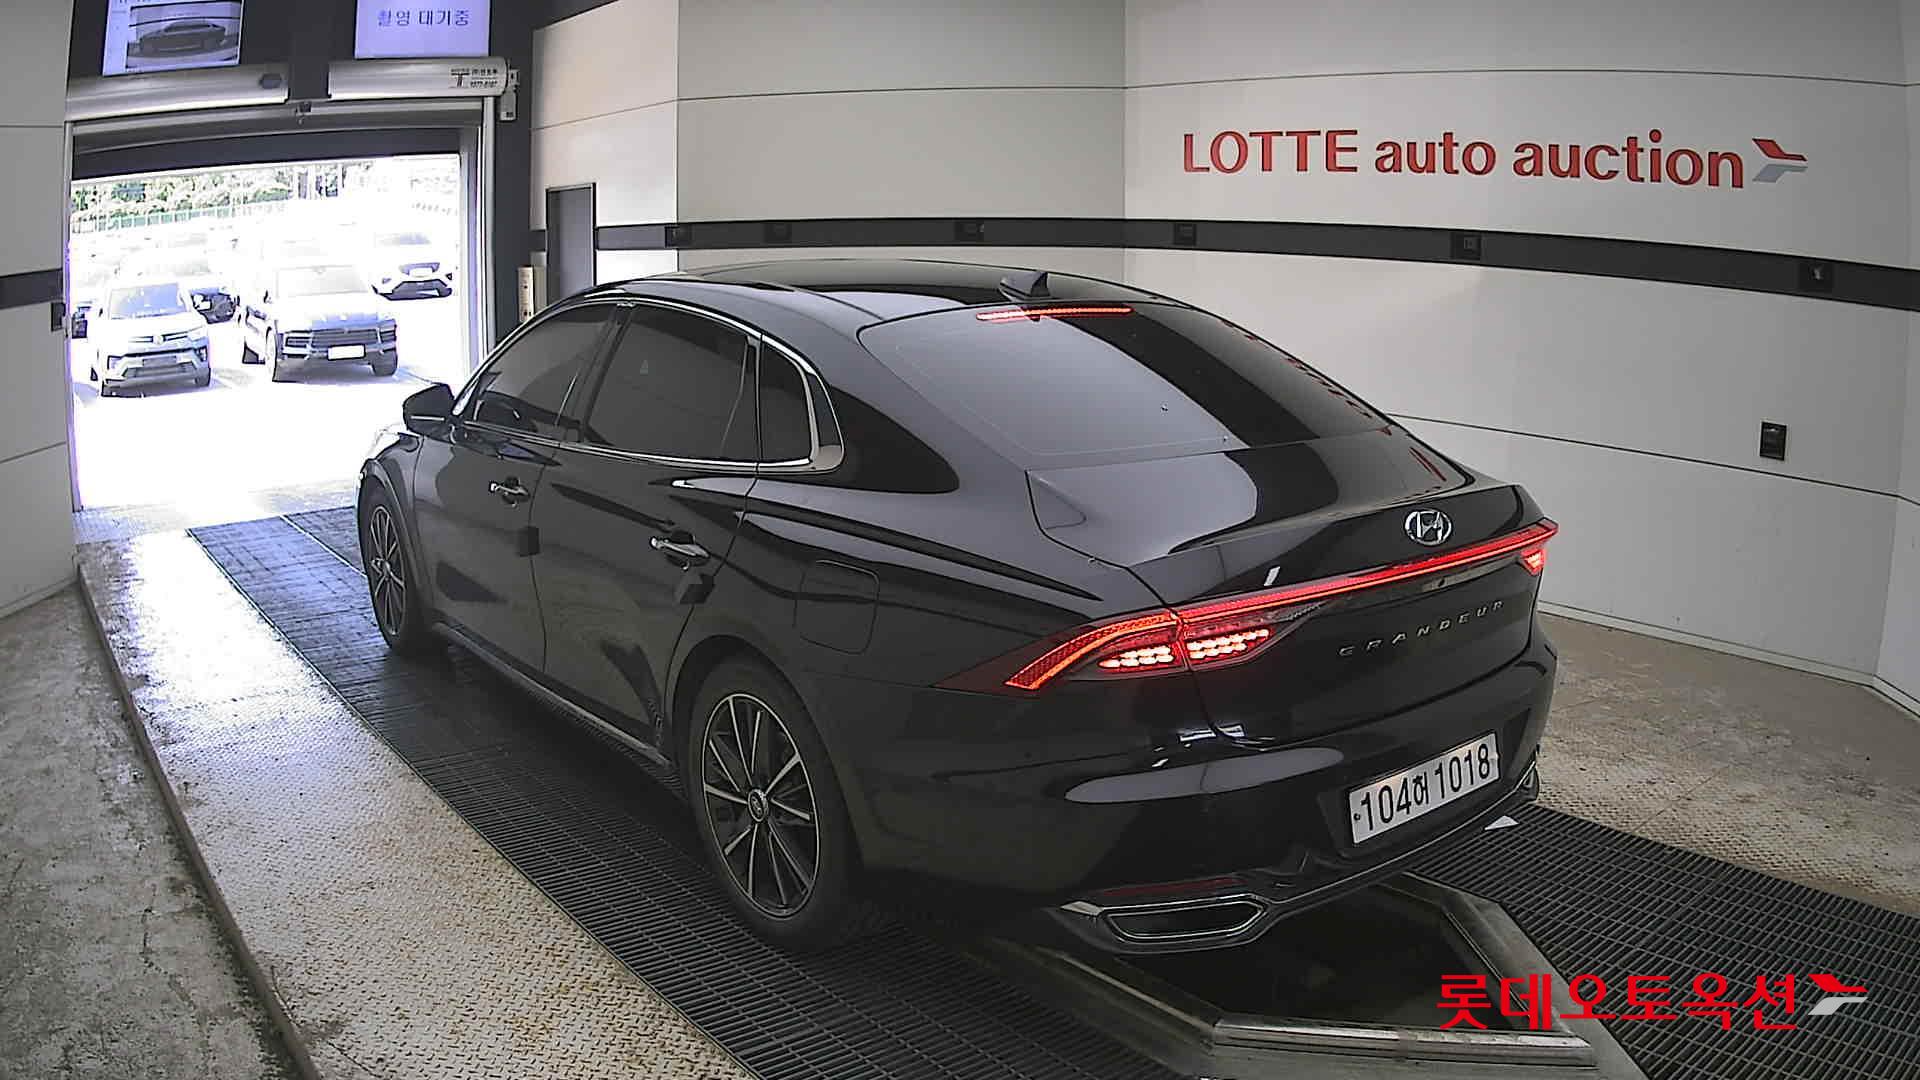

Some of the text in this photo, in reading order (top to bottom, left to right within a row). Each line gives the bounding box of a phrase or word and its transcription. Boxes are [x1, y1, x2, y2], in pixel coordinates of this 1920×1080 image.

[418, 9, 470, 26] 대기중
[1183, 129, 1745, 188] LOTTE auto auction
[1337, 599, 1504, 657] GRANDEUR
[1434, 742, 1491, 799] 1018
